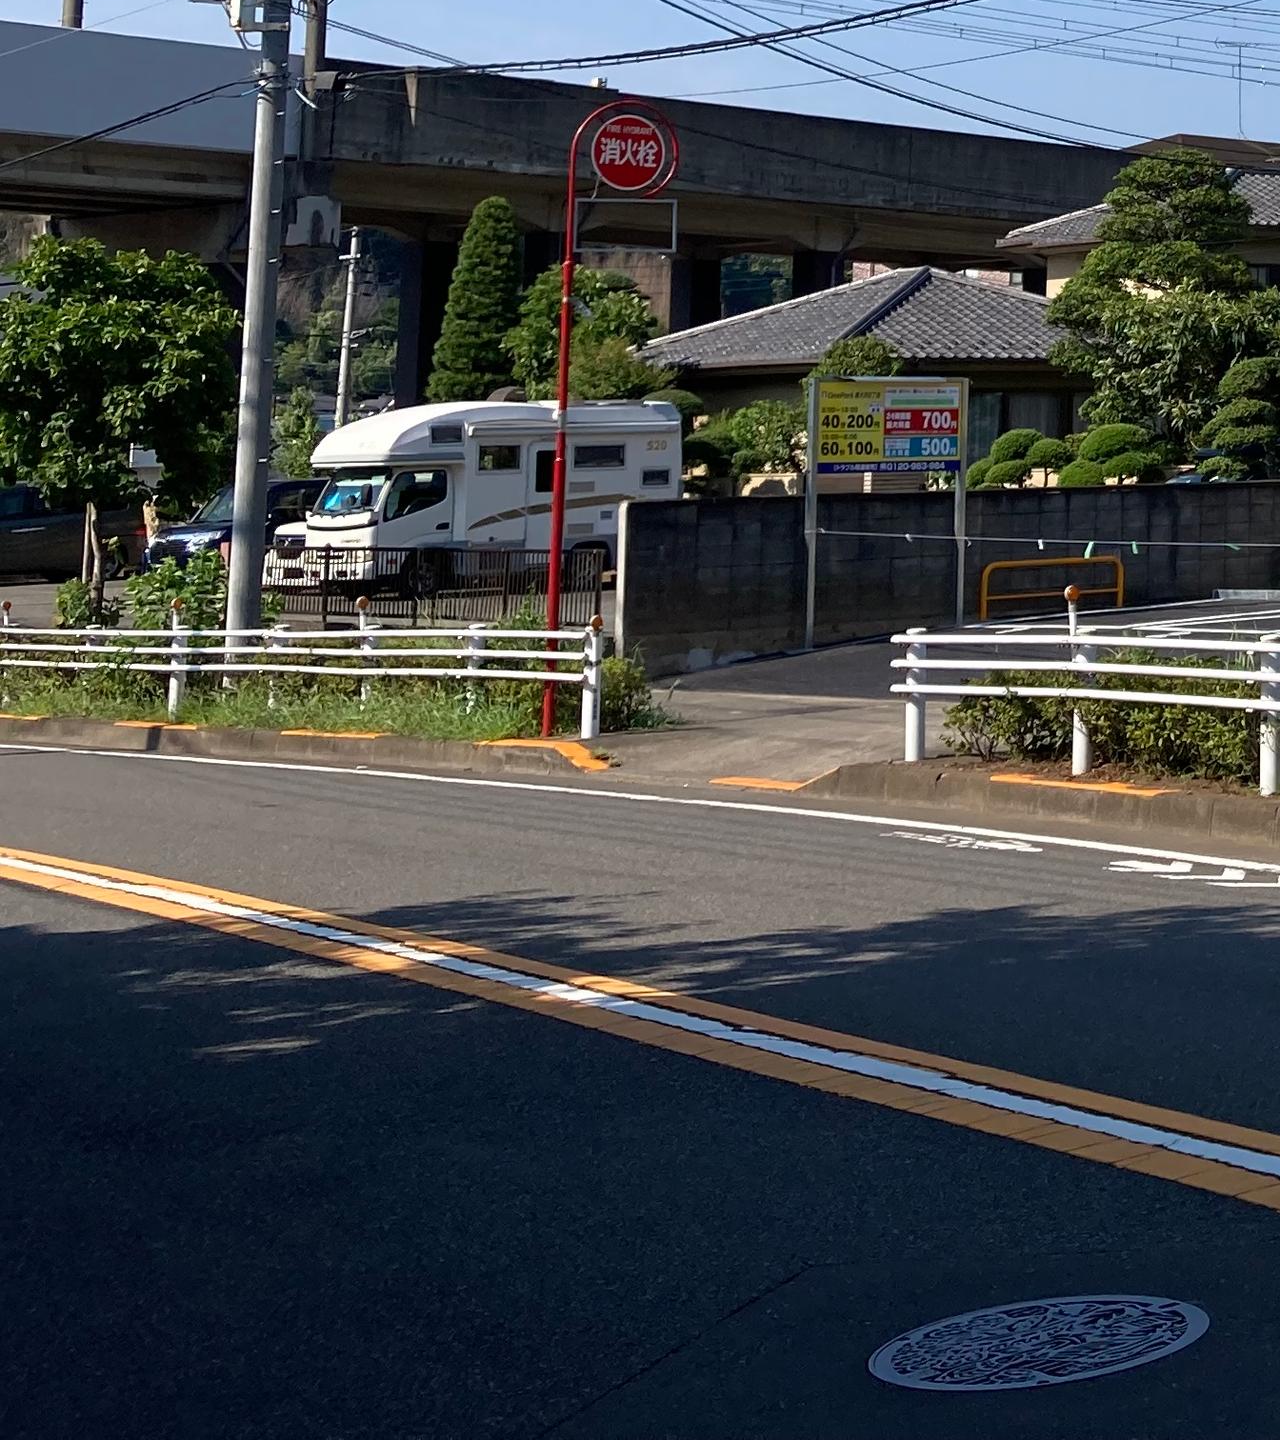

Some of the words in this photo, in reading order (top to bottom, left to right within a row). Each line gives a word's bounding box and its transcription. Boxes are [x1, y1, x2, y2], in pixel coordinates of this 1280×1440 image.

[606, 124, 621, 134] FIRE
[622, 125, 653, 136] HYDRANT
[599, 137, 658, 168] 消火栓
